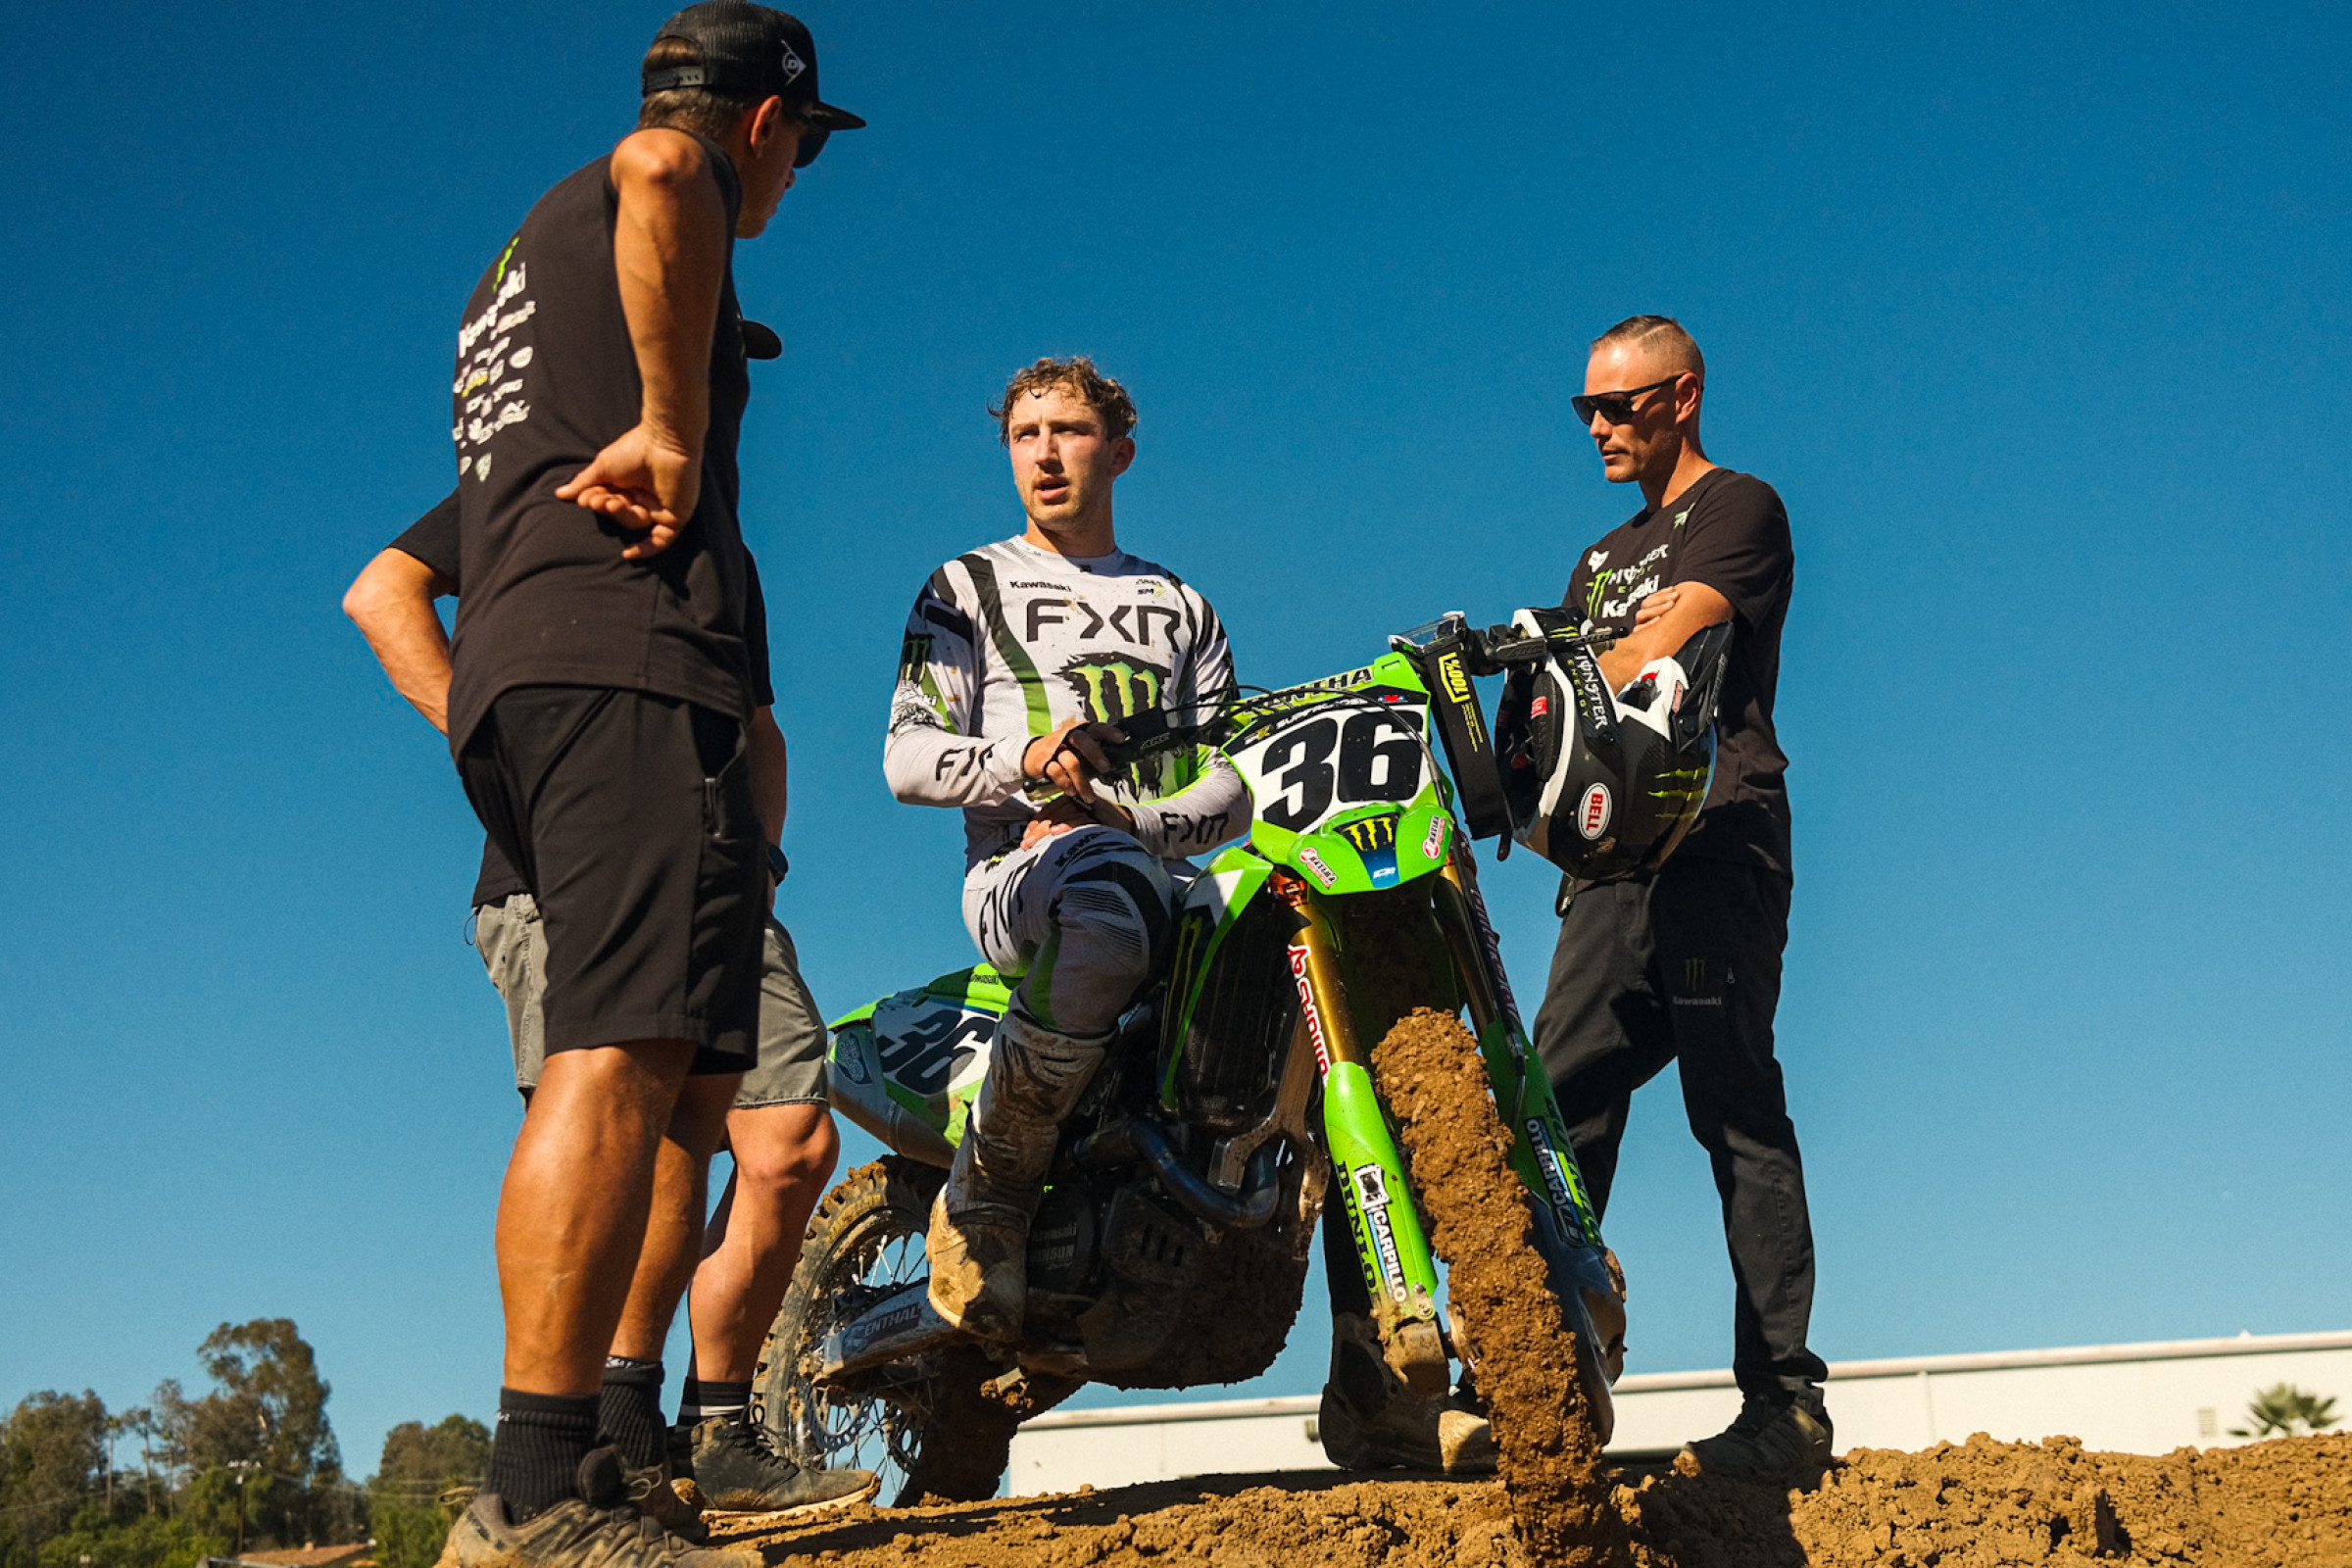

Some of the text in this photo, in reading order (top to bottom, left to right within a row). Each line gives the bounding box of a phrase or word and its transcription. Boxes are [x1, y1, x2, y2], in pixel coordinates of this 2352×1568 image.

[1009, 580, 1072, 592] Kawasaki
[1026, 598, 1182, 655] FXR
[1443, 658, 1469, 695] 100%
[1567, 659, 1590, 718] ENERGY
[1261, 709, 1425, 836] 36
[1586, 792, 1604, 831] BELL
[875, 1009, 1000, 1095] 36
[1526, 1118, 1567, 1205] CARRILLO
[1373, 1211, 1408, 1303] CARRILLO
